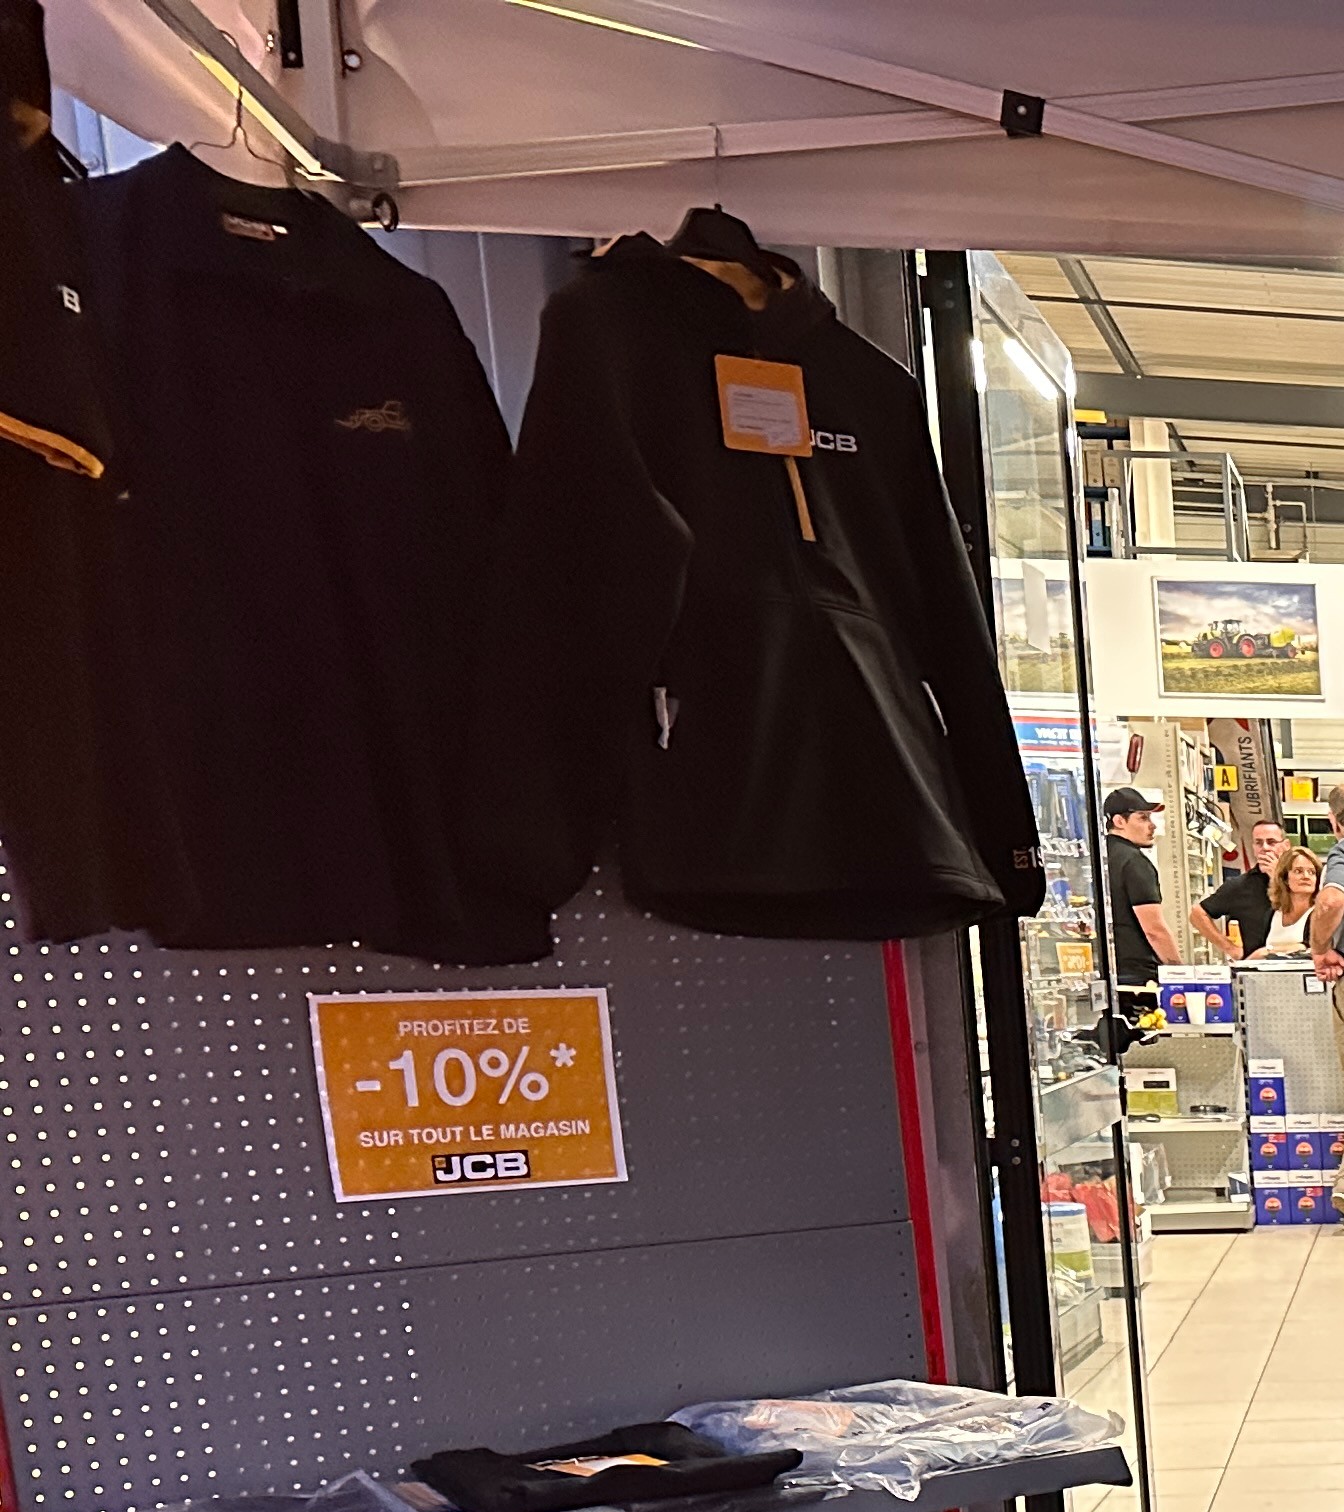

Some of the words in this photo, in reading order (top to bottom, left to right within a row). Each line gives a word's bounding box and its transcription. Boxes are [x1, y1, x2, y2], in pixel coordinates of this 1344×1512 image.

[1220, 769, 1231, 788] A
[1238, 735, 1262, 815] LUBRIFIANTS
[398, 1018, 499, 1037] PROFITEZ
[503, 1017, 531, 1034] DE
[359, 1130, 404, 1147] SUR
[409, 1126, 464, 1144] TOUT
[470, 1124, 495, 1141] LE
[500, 1120, 590, 1140] MAGASIN
[435, 1152, 528, 1182] JCB
